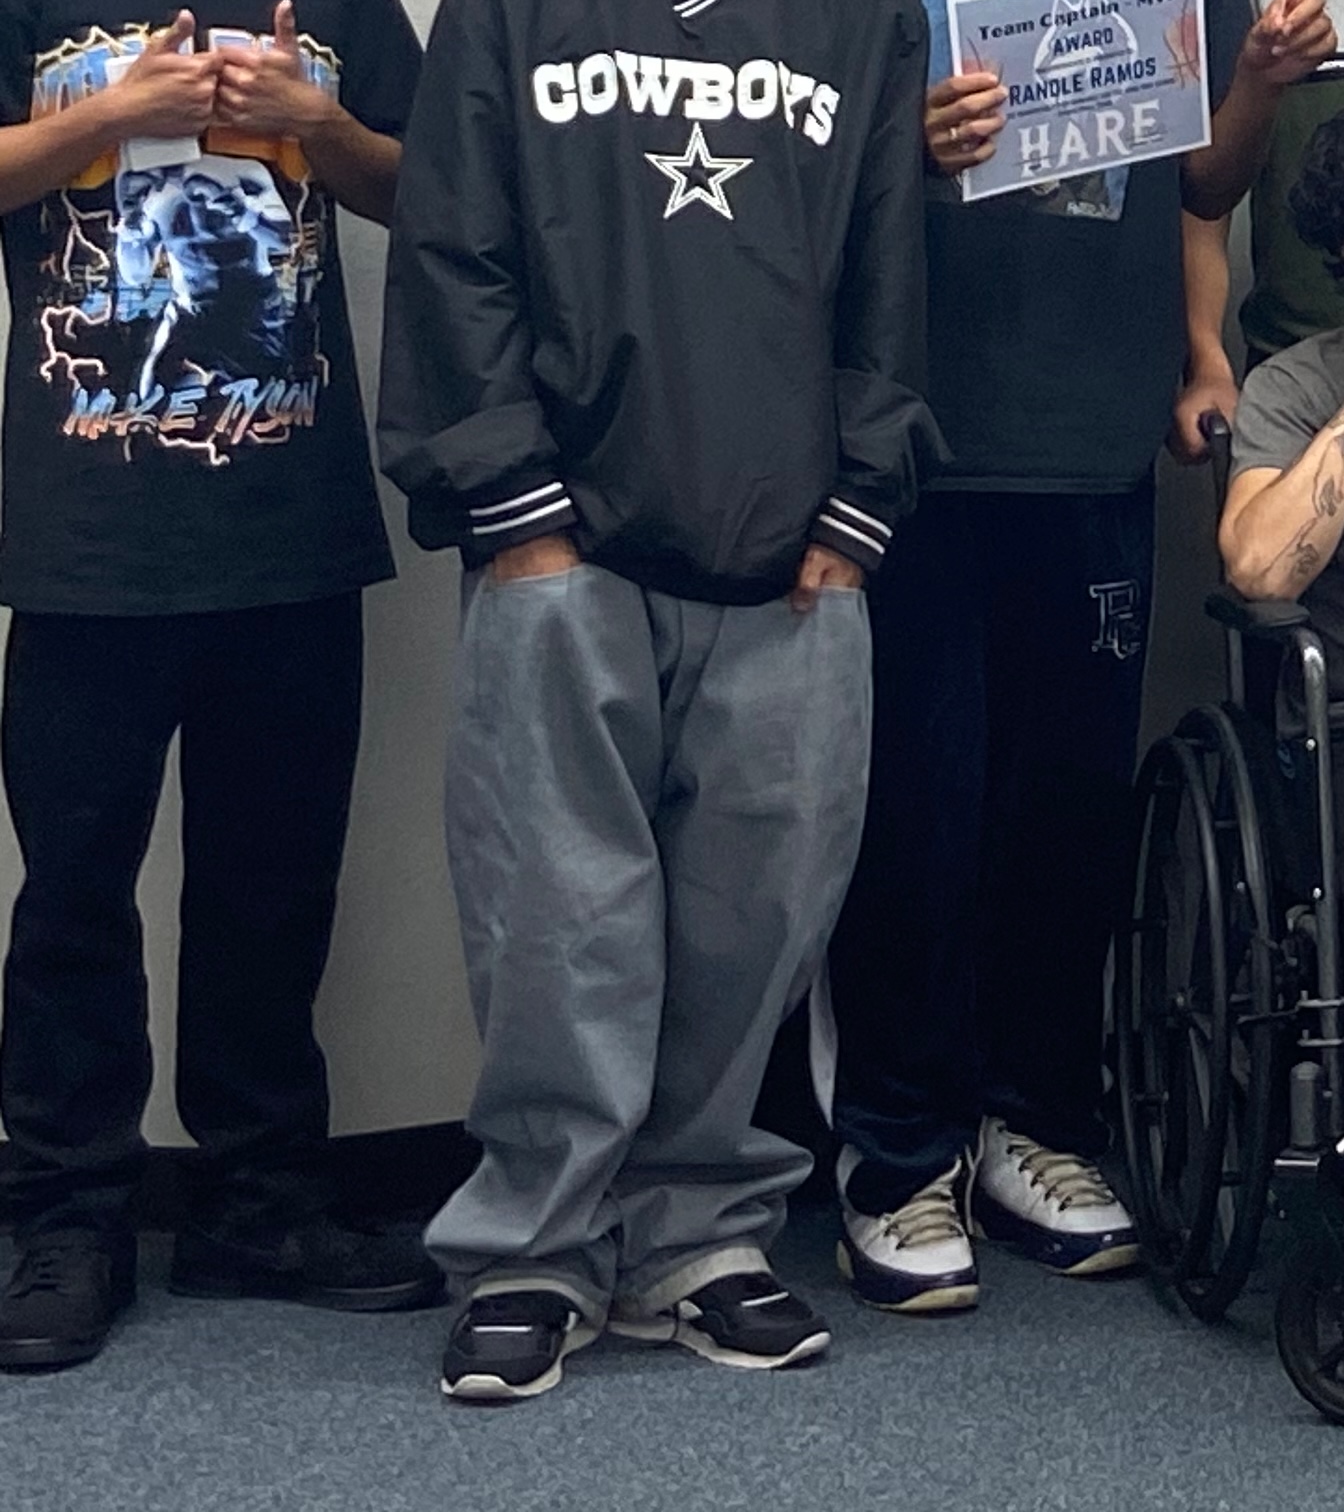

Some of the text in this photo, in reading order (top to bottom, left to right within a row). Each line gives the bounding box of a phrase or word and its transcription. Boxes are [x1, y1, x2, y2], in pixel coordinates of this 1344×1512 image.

[978, 18, 1035, 41] Team
[1040, 0, 1120, 29] Captain
[1053, 27, 1114, 57] AWARD
[532, 50, 841, 146] COWBOYS
[1009, 73, 1084, 107] RANDLE
[1090, 56, 1157, 89] RAMOS
[1017, 99, 1161, 178] HARE
